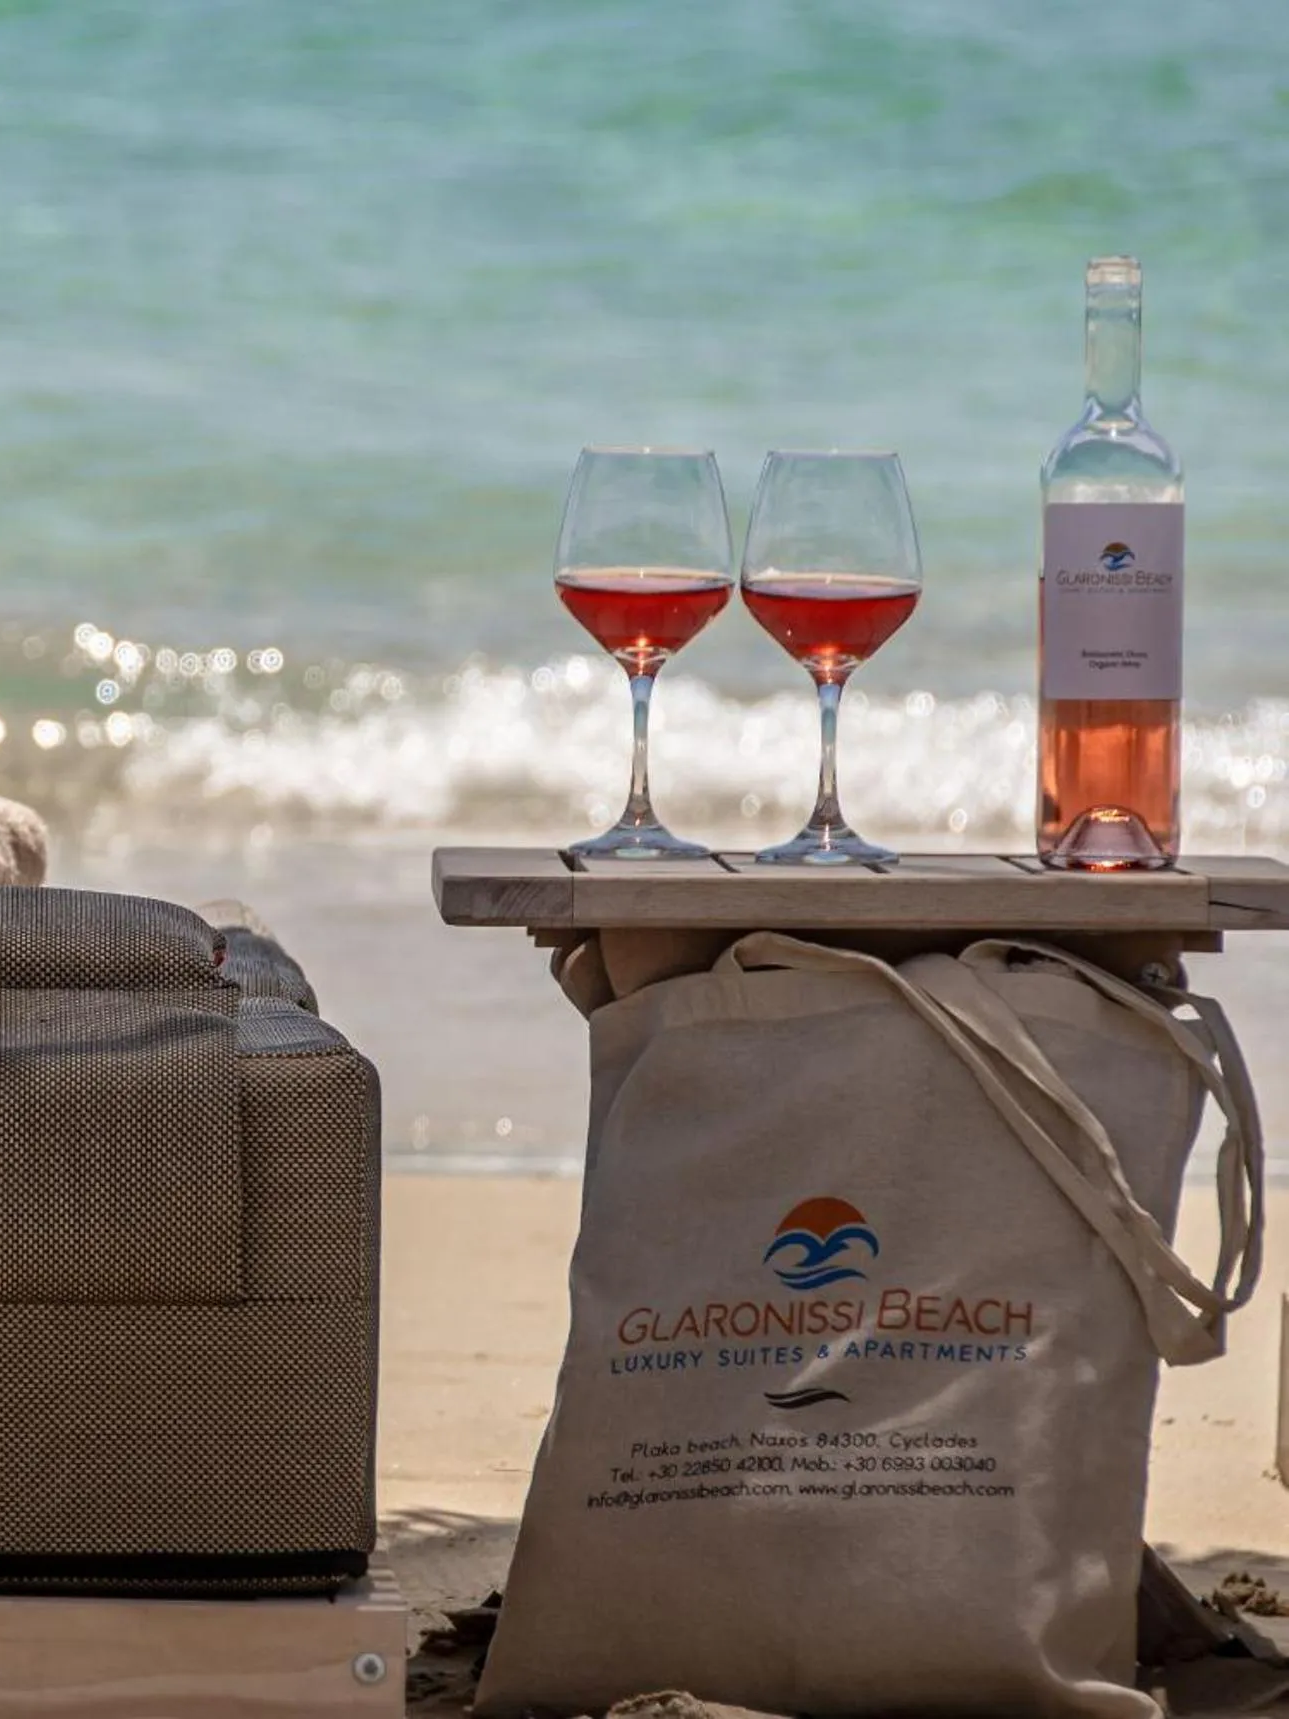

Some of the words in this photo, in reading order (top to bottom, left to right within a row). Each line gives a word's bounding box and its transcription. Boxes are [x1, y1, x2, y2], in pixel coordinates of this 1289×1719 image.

[618, 1301, 864, 1345] GLARONISSI
[877, 1288, 1033, 1336] BEACH
[611, 1350, 703, 1374] LUXURY
[718, 1346, 804, 1367] SUITES
[817, 1344, 829, 1359] &
[844, 1339, 1028, 1362] APARTMENTS
[750, 1432, 808, 1448] Naxos
[888, 1432, 978, 1450] Cyclades
[843, 1456, 877, 1472] +30
[881, 1457, 925, 1472] 6993
[930, 1456, 997, 1472] 003040
